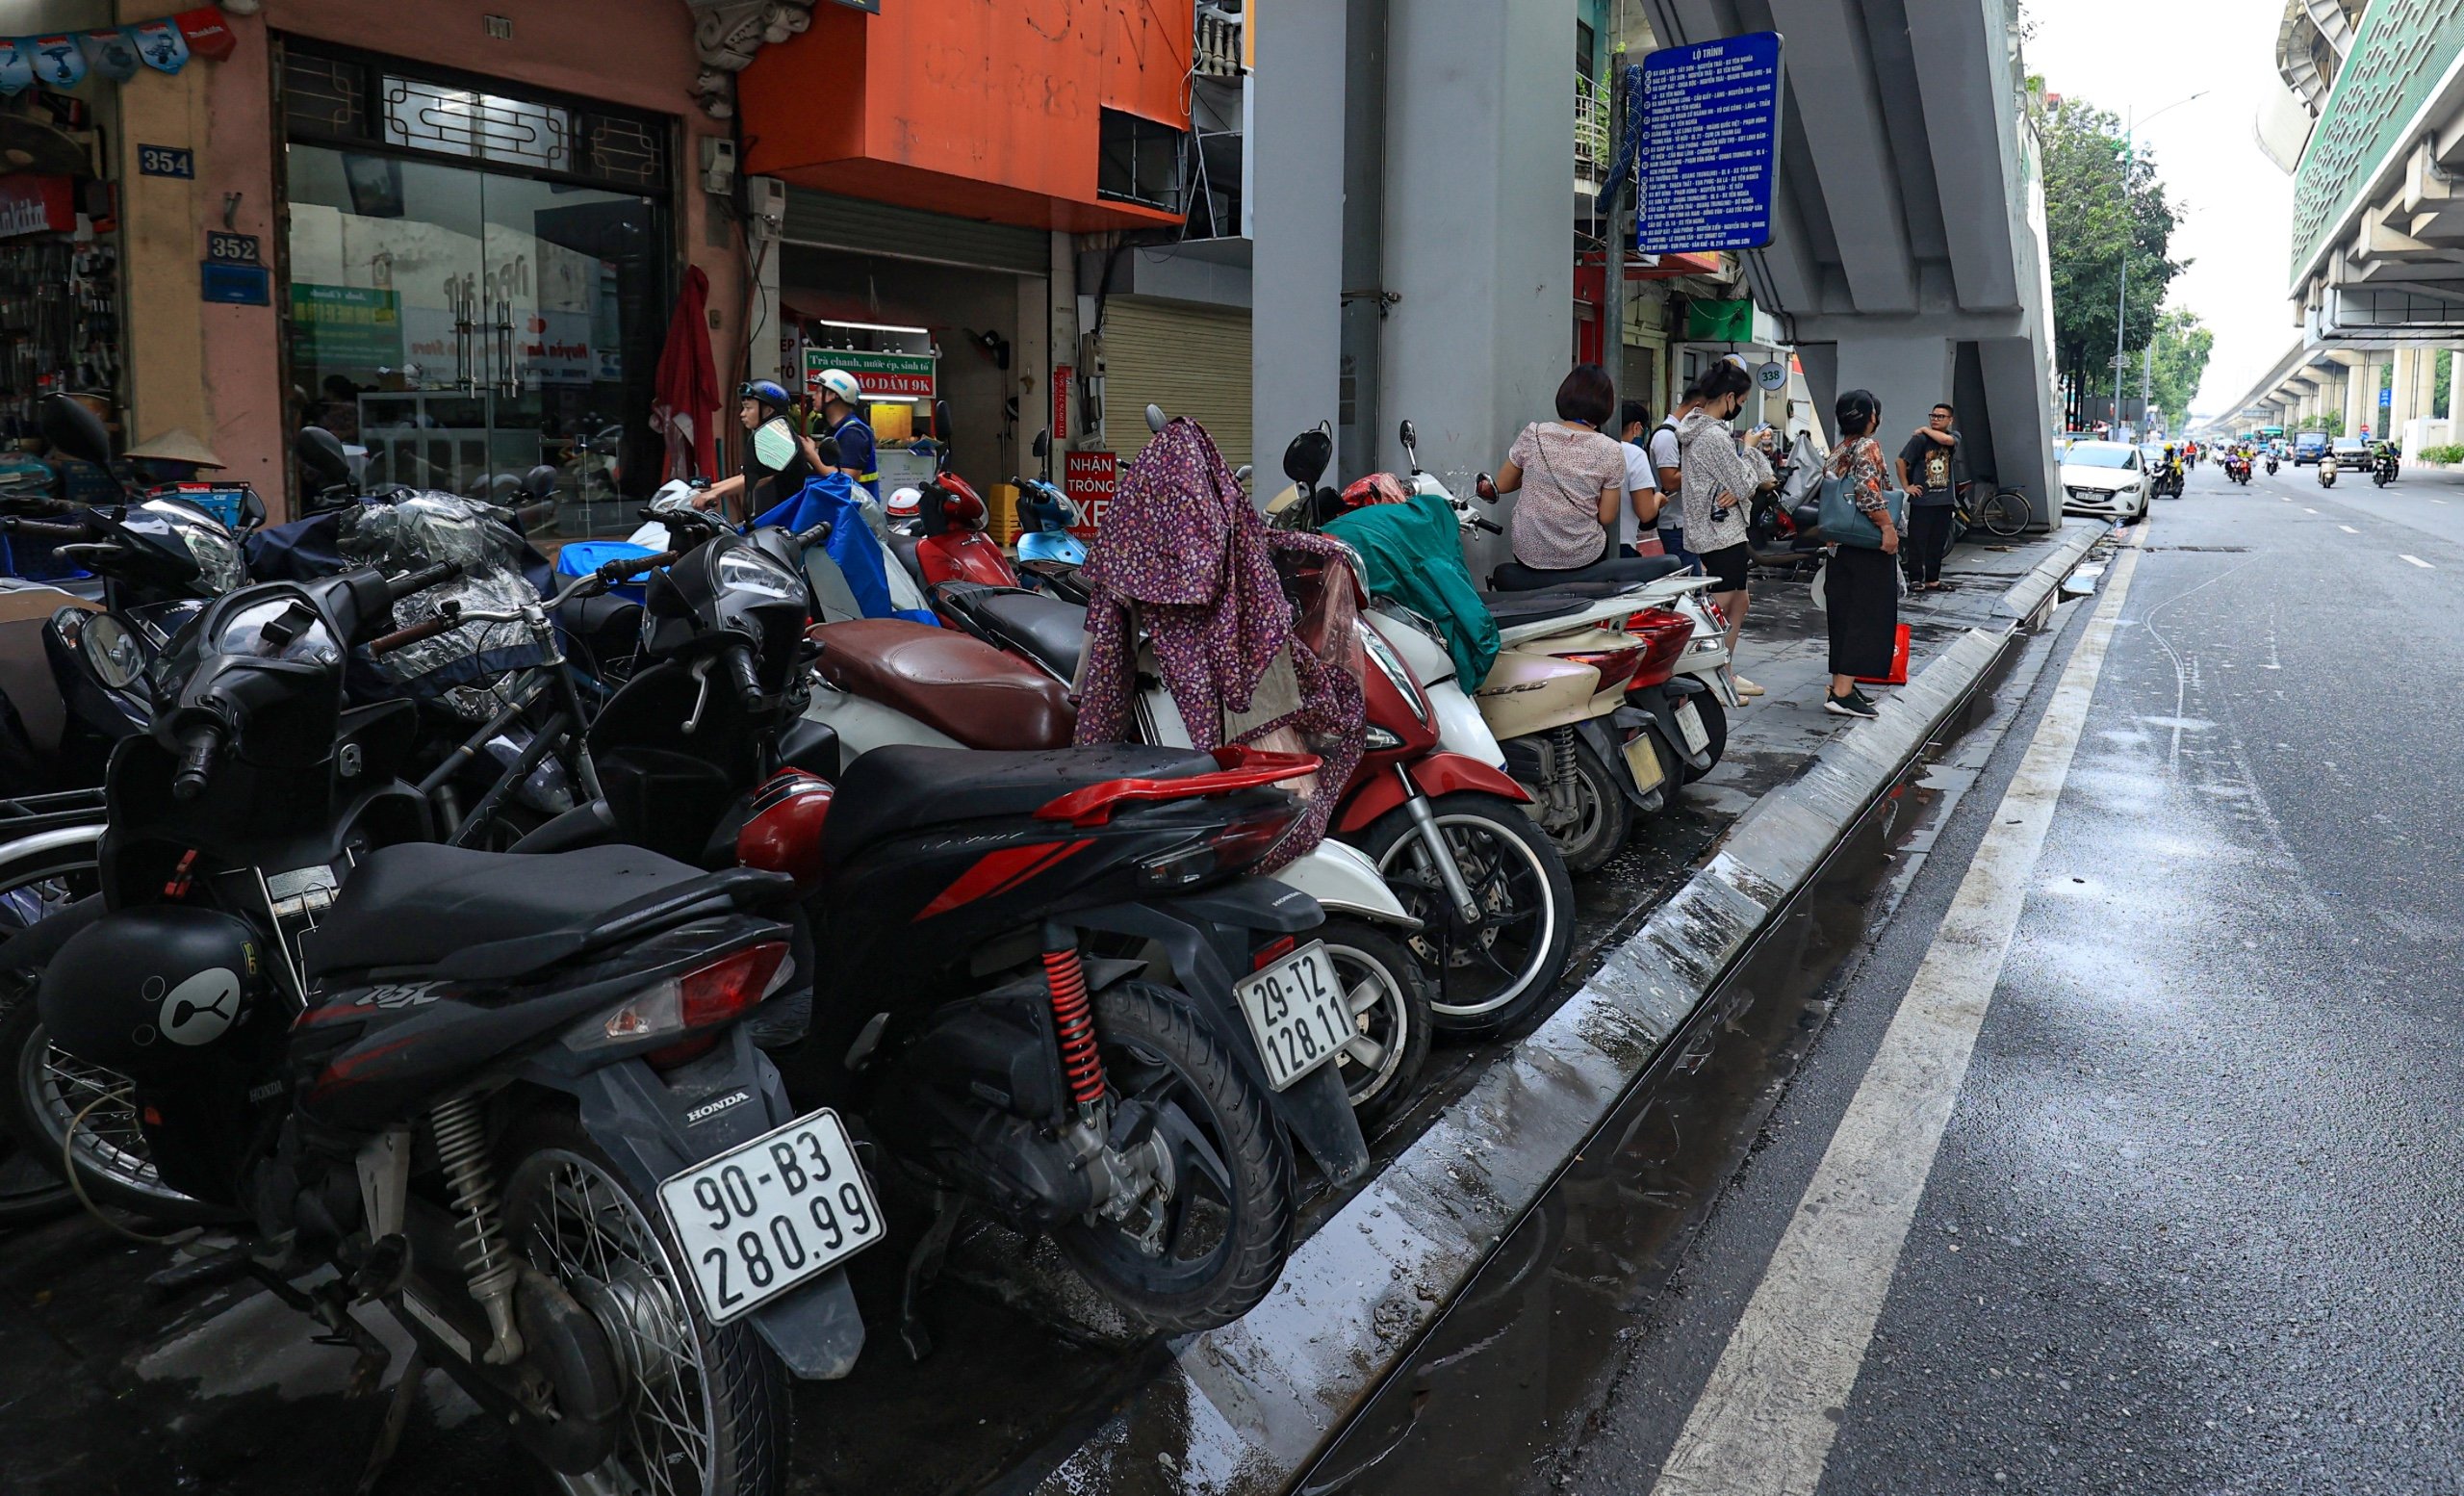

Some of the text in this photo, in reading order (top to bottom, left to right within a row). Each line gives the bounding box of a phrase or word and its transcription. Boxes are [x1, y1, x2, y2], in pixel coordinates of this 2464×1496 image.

[1692, 45, 1724, 62] LỘ TRÌNH
[144, 149, 190, 174] 354
[212, 237, 257, 260] 352
[809, 353, 829, 367] Trà
[830, 357, 862, 369] chanh,
[900, 361, 918, 371] sinh
[878, 374, 909, 392] DẦM
[911, 379, 931, 392] 9K
[1761, 370, 1781, 382] 338
[1070, 454, 1112, 475] NHẬN
[1068, 477, 1116, 493] TRÔNG
[1072, 500, 1110, 528] XE
[1253, 954, 1327, 1028] 29-T2
[1266, 994, 1351, 1079] 128.11
[686, 1091, 750, 1122] HONDA
[692, 1130, 833, 1231] 90-B3
[702, 1181, 872, 1310] 280.99
